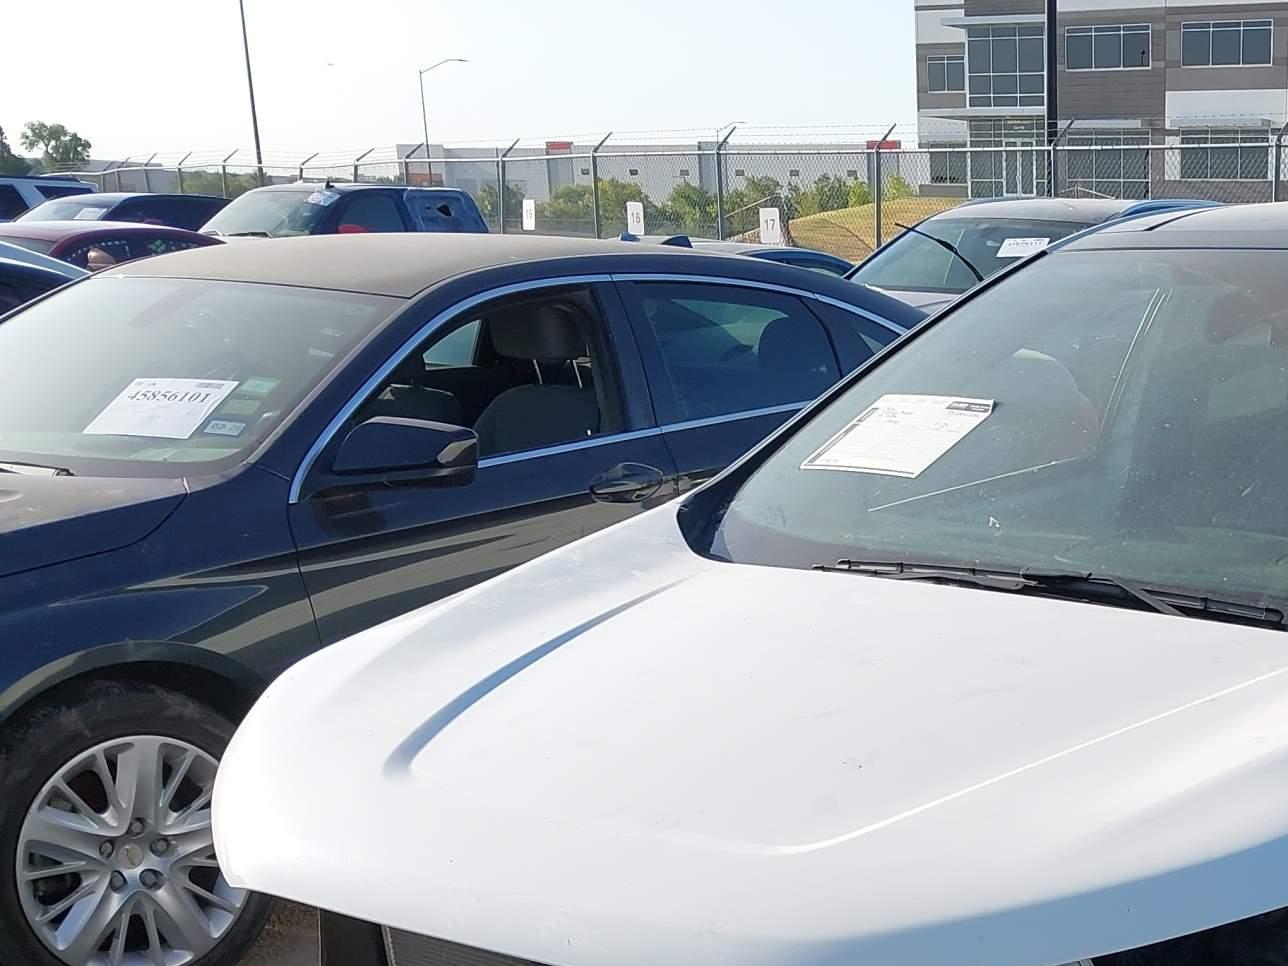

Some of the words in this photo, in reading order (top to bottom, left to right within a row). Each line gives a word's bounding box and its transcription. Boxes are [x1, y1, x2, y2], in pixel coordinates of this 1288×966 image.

[631, 211, 641, 224] 16
[764, 218, 776, 231] 17
[127, 390, 212, 403] 45856101
